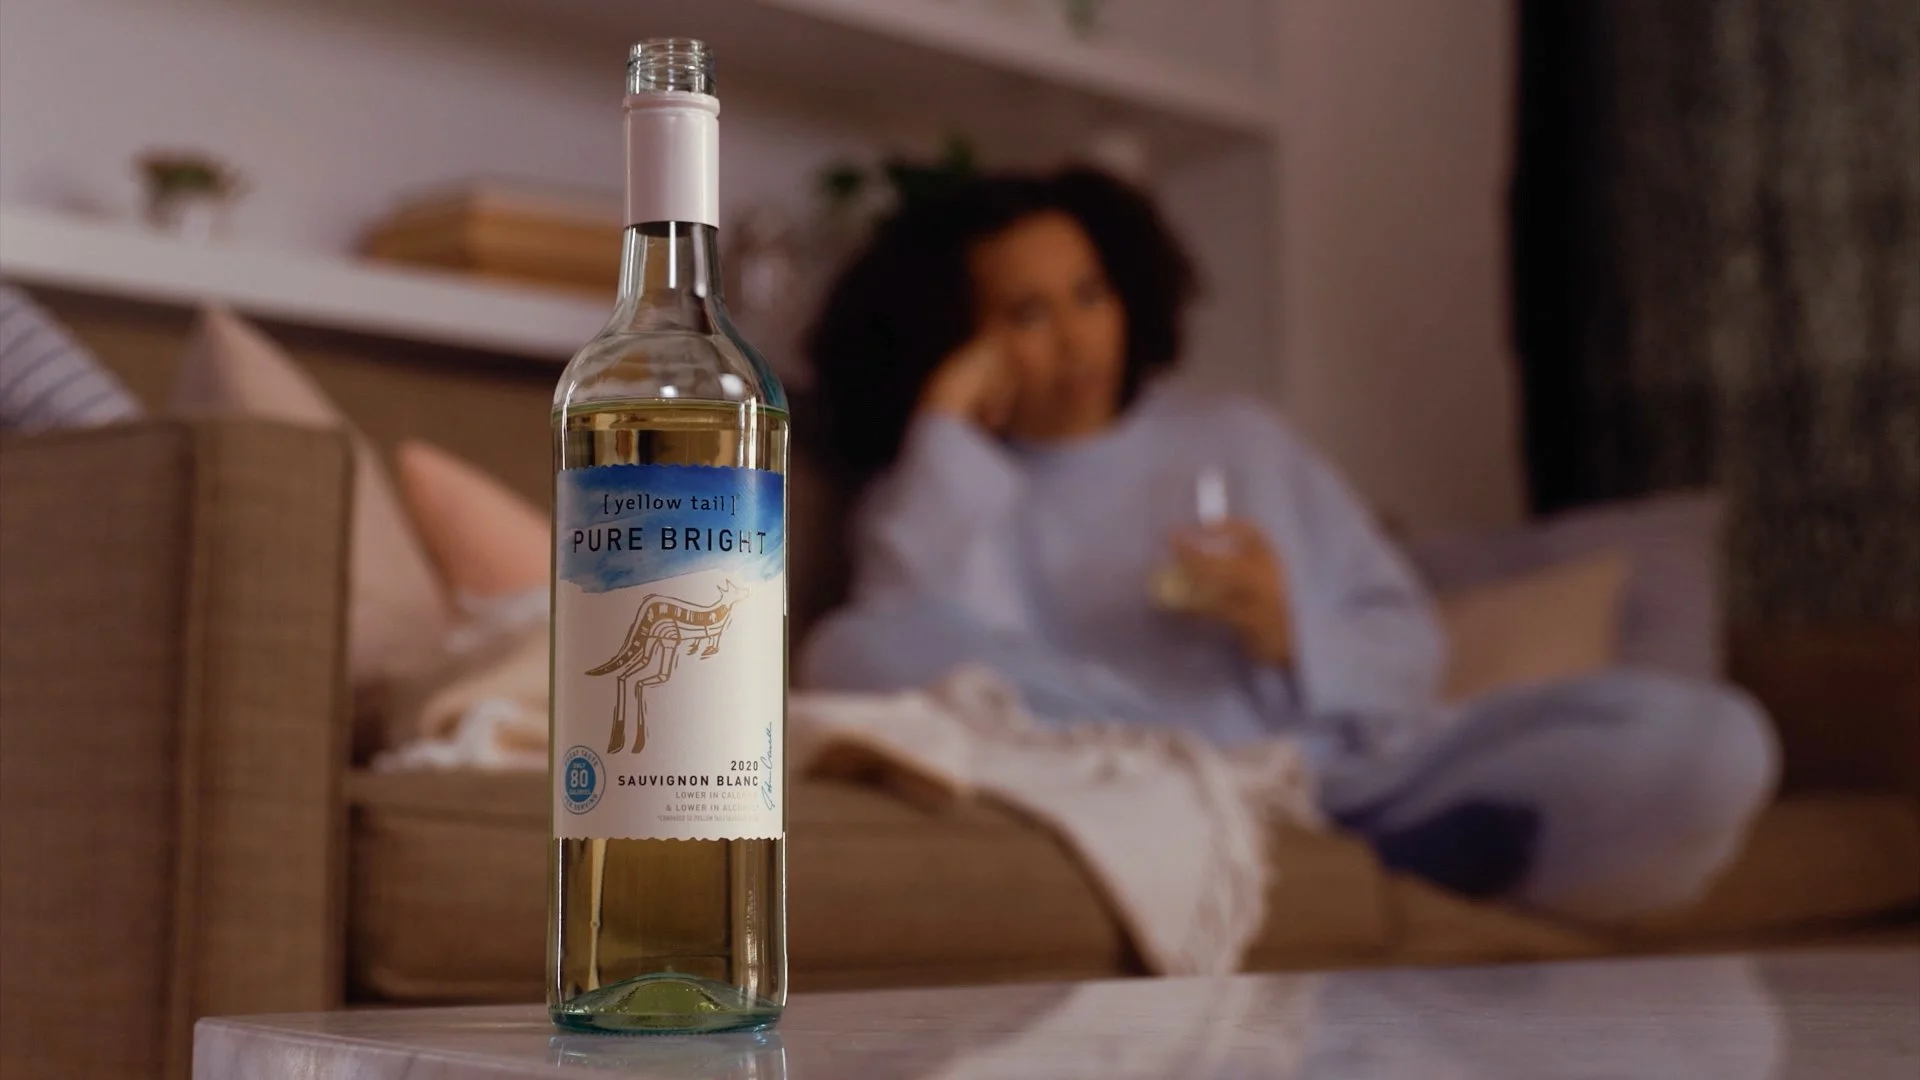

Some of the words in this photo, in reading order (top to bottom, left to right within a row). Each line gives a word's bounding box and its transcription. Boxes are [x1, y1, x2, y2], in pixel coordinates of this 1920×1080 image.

[574, 527, 643, 553] PURE
[661, 527, 766, 554] BRIGHT
[730, 760, 759, 771] 2020
[571, 769, 588, 788] 80
[618, 775, 709, 786] SAUVIGNON
[716, 775, 759, 786] BLANC
[675, 791, 706, 800] LOWER
[709, 791, 719, 800] IN
[665, 804, 672, 812] &
[675, 804, 707, 812] LOWER
[710, 804, 720, 812] IN
